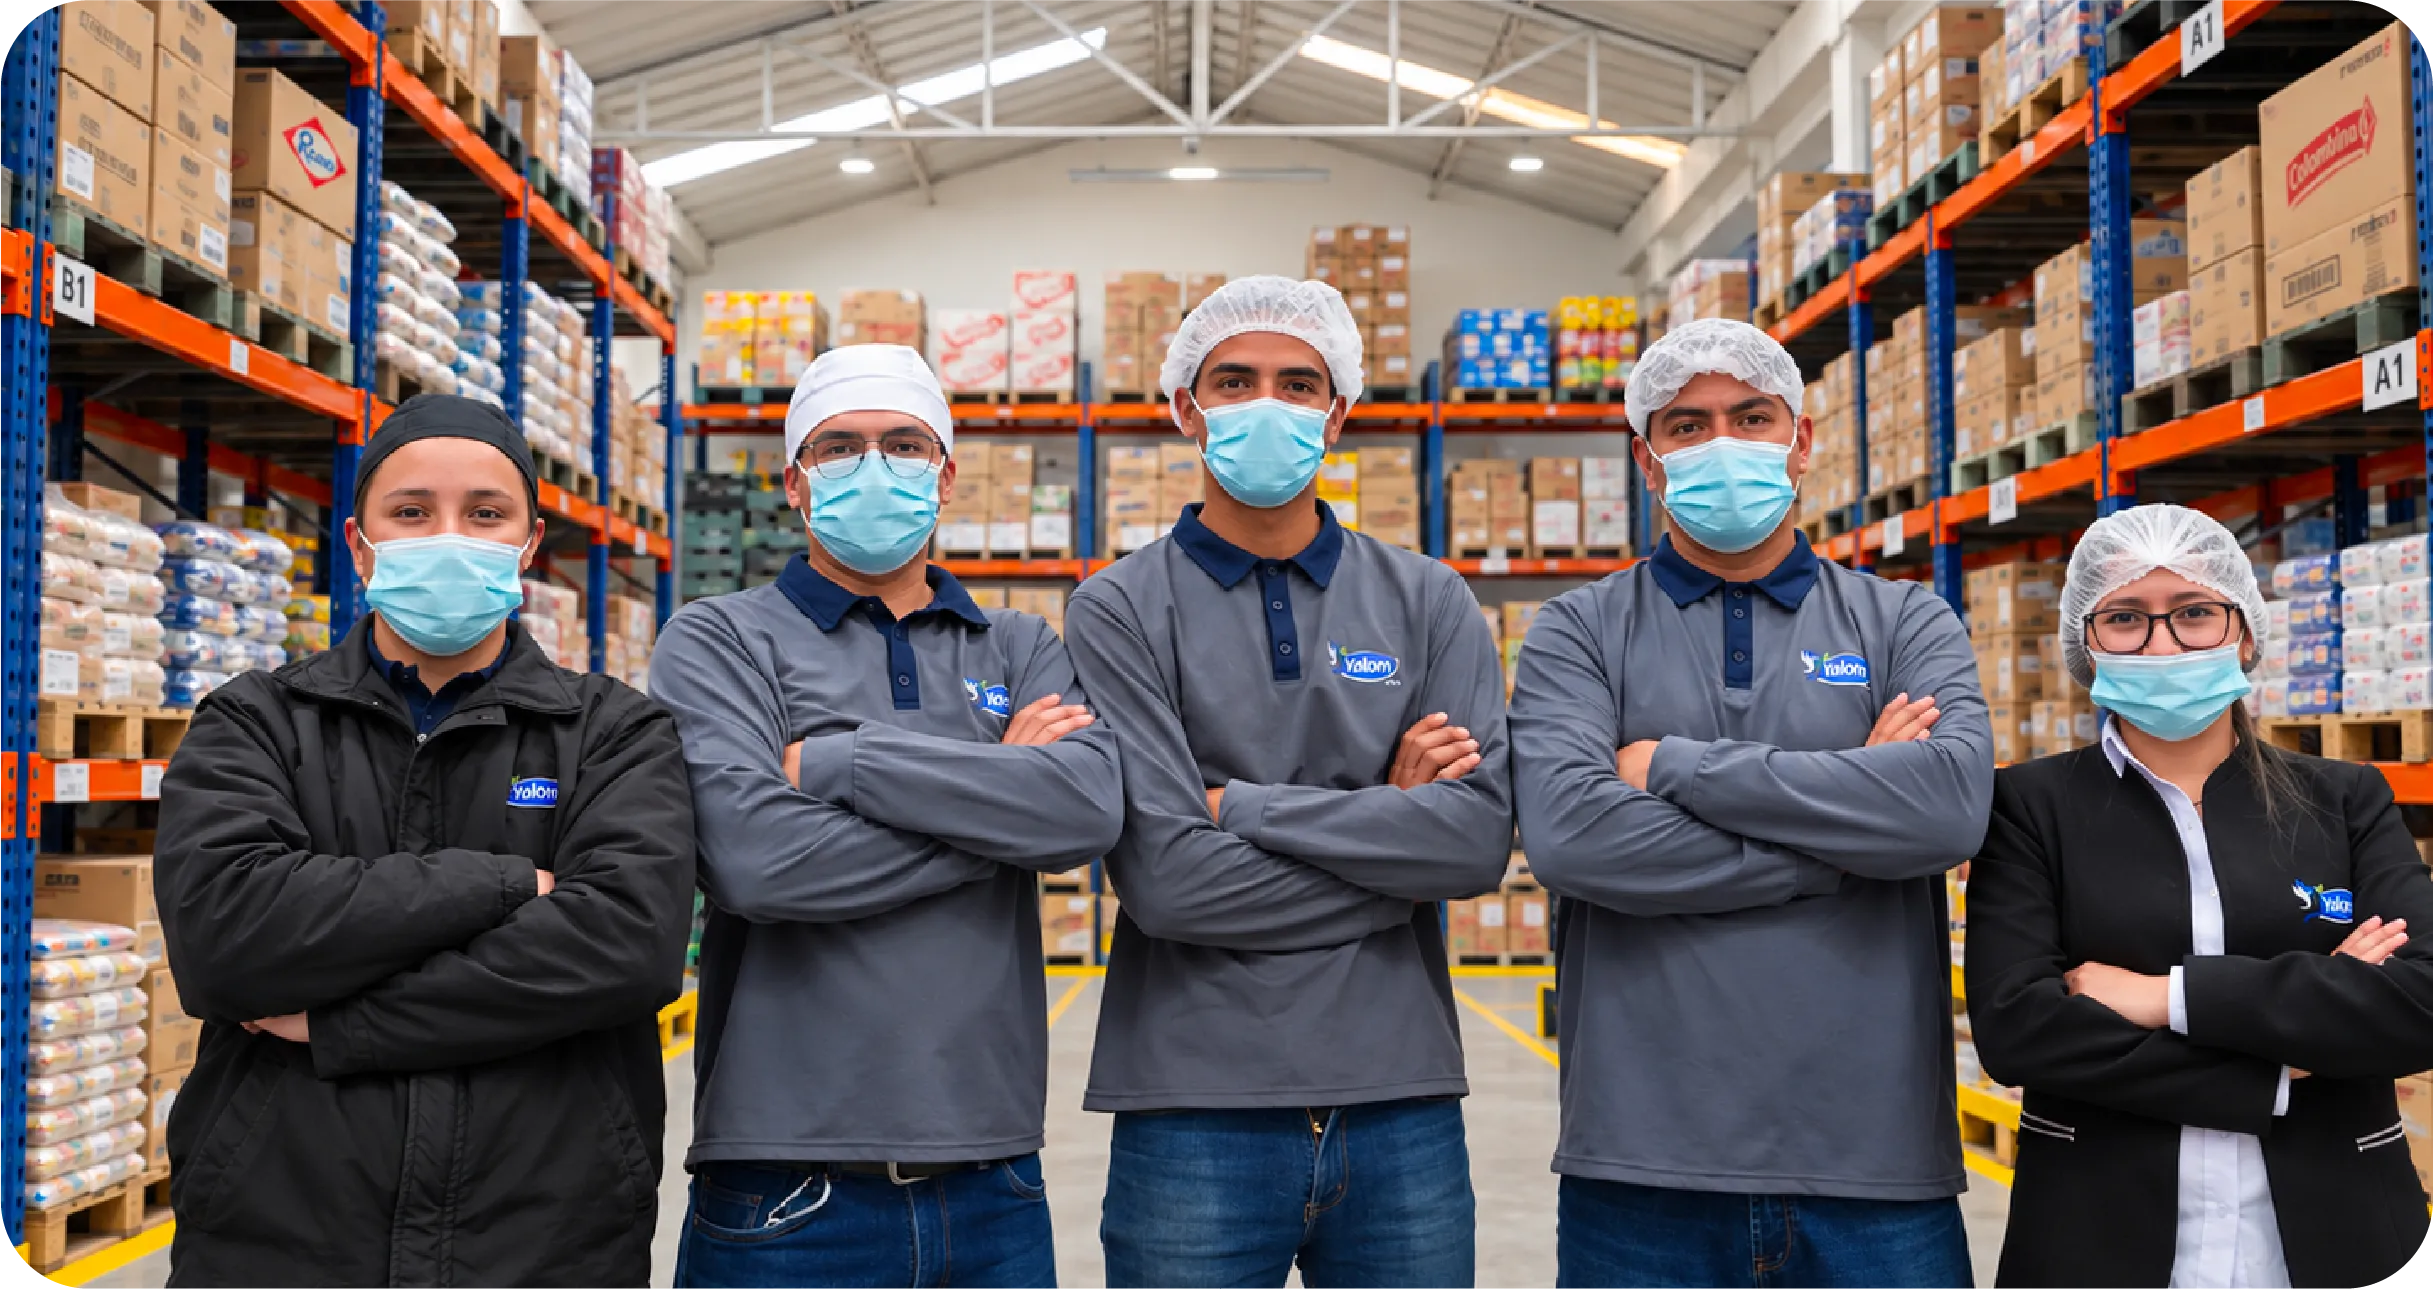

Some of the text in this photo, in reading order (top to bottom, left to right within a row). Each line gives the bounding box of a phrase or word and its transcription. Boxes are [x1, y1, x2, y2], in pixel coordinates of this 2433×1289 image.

[2189, 12, 2214, 56] A1
[62, 265, 85, 308] B1
[2374, 352, 2403, 394] A1
